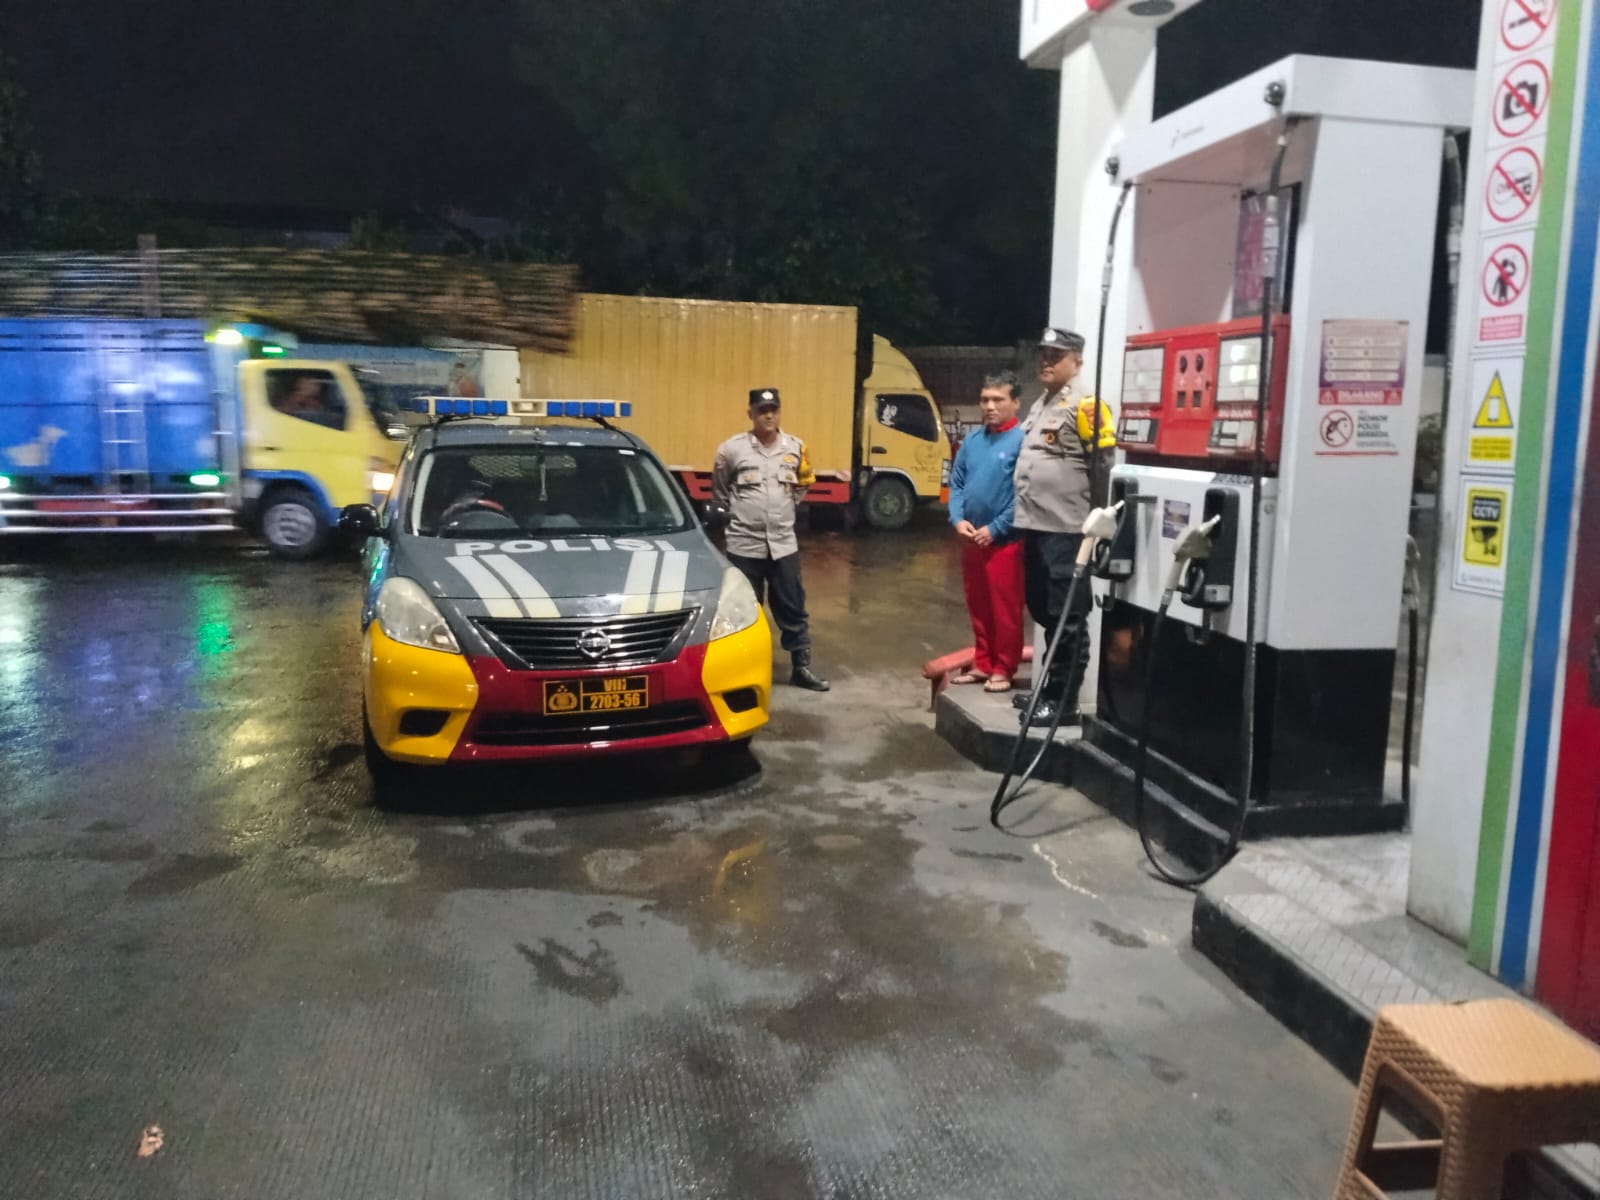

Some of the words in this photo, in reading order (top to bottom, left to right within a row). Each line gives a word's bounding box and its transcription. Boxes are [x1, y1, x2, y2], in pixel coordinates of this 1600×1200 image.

[1473, 505, 1499, 519] CCTV
[455, 538, 676, 556] POLISI
[590, 692, 640, 709] 2703-56
